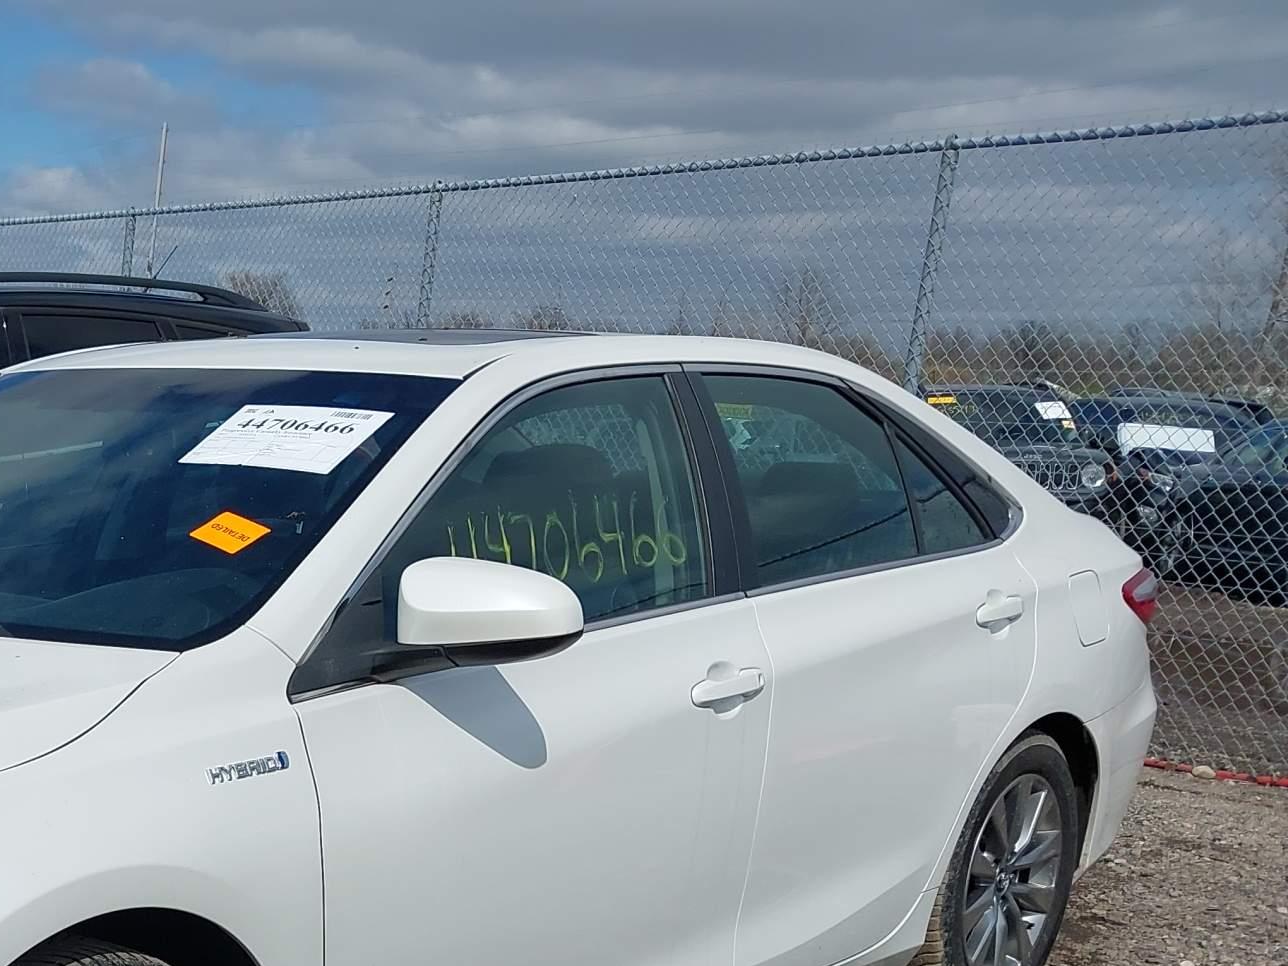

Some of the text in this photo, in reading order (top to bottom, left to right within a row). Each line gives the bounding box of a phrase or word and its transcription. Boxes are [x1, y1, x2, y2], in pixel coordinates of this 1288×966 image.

[237, 418, 357, 434] 44706466
[211, 522, 251, 542] DETAILED
[206, 756, 279, 785] HYBRID
